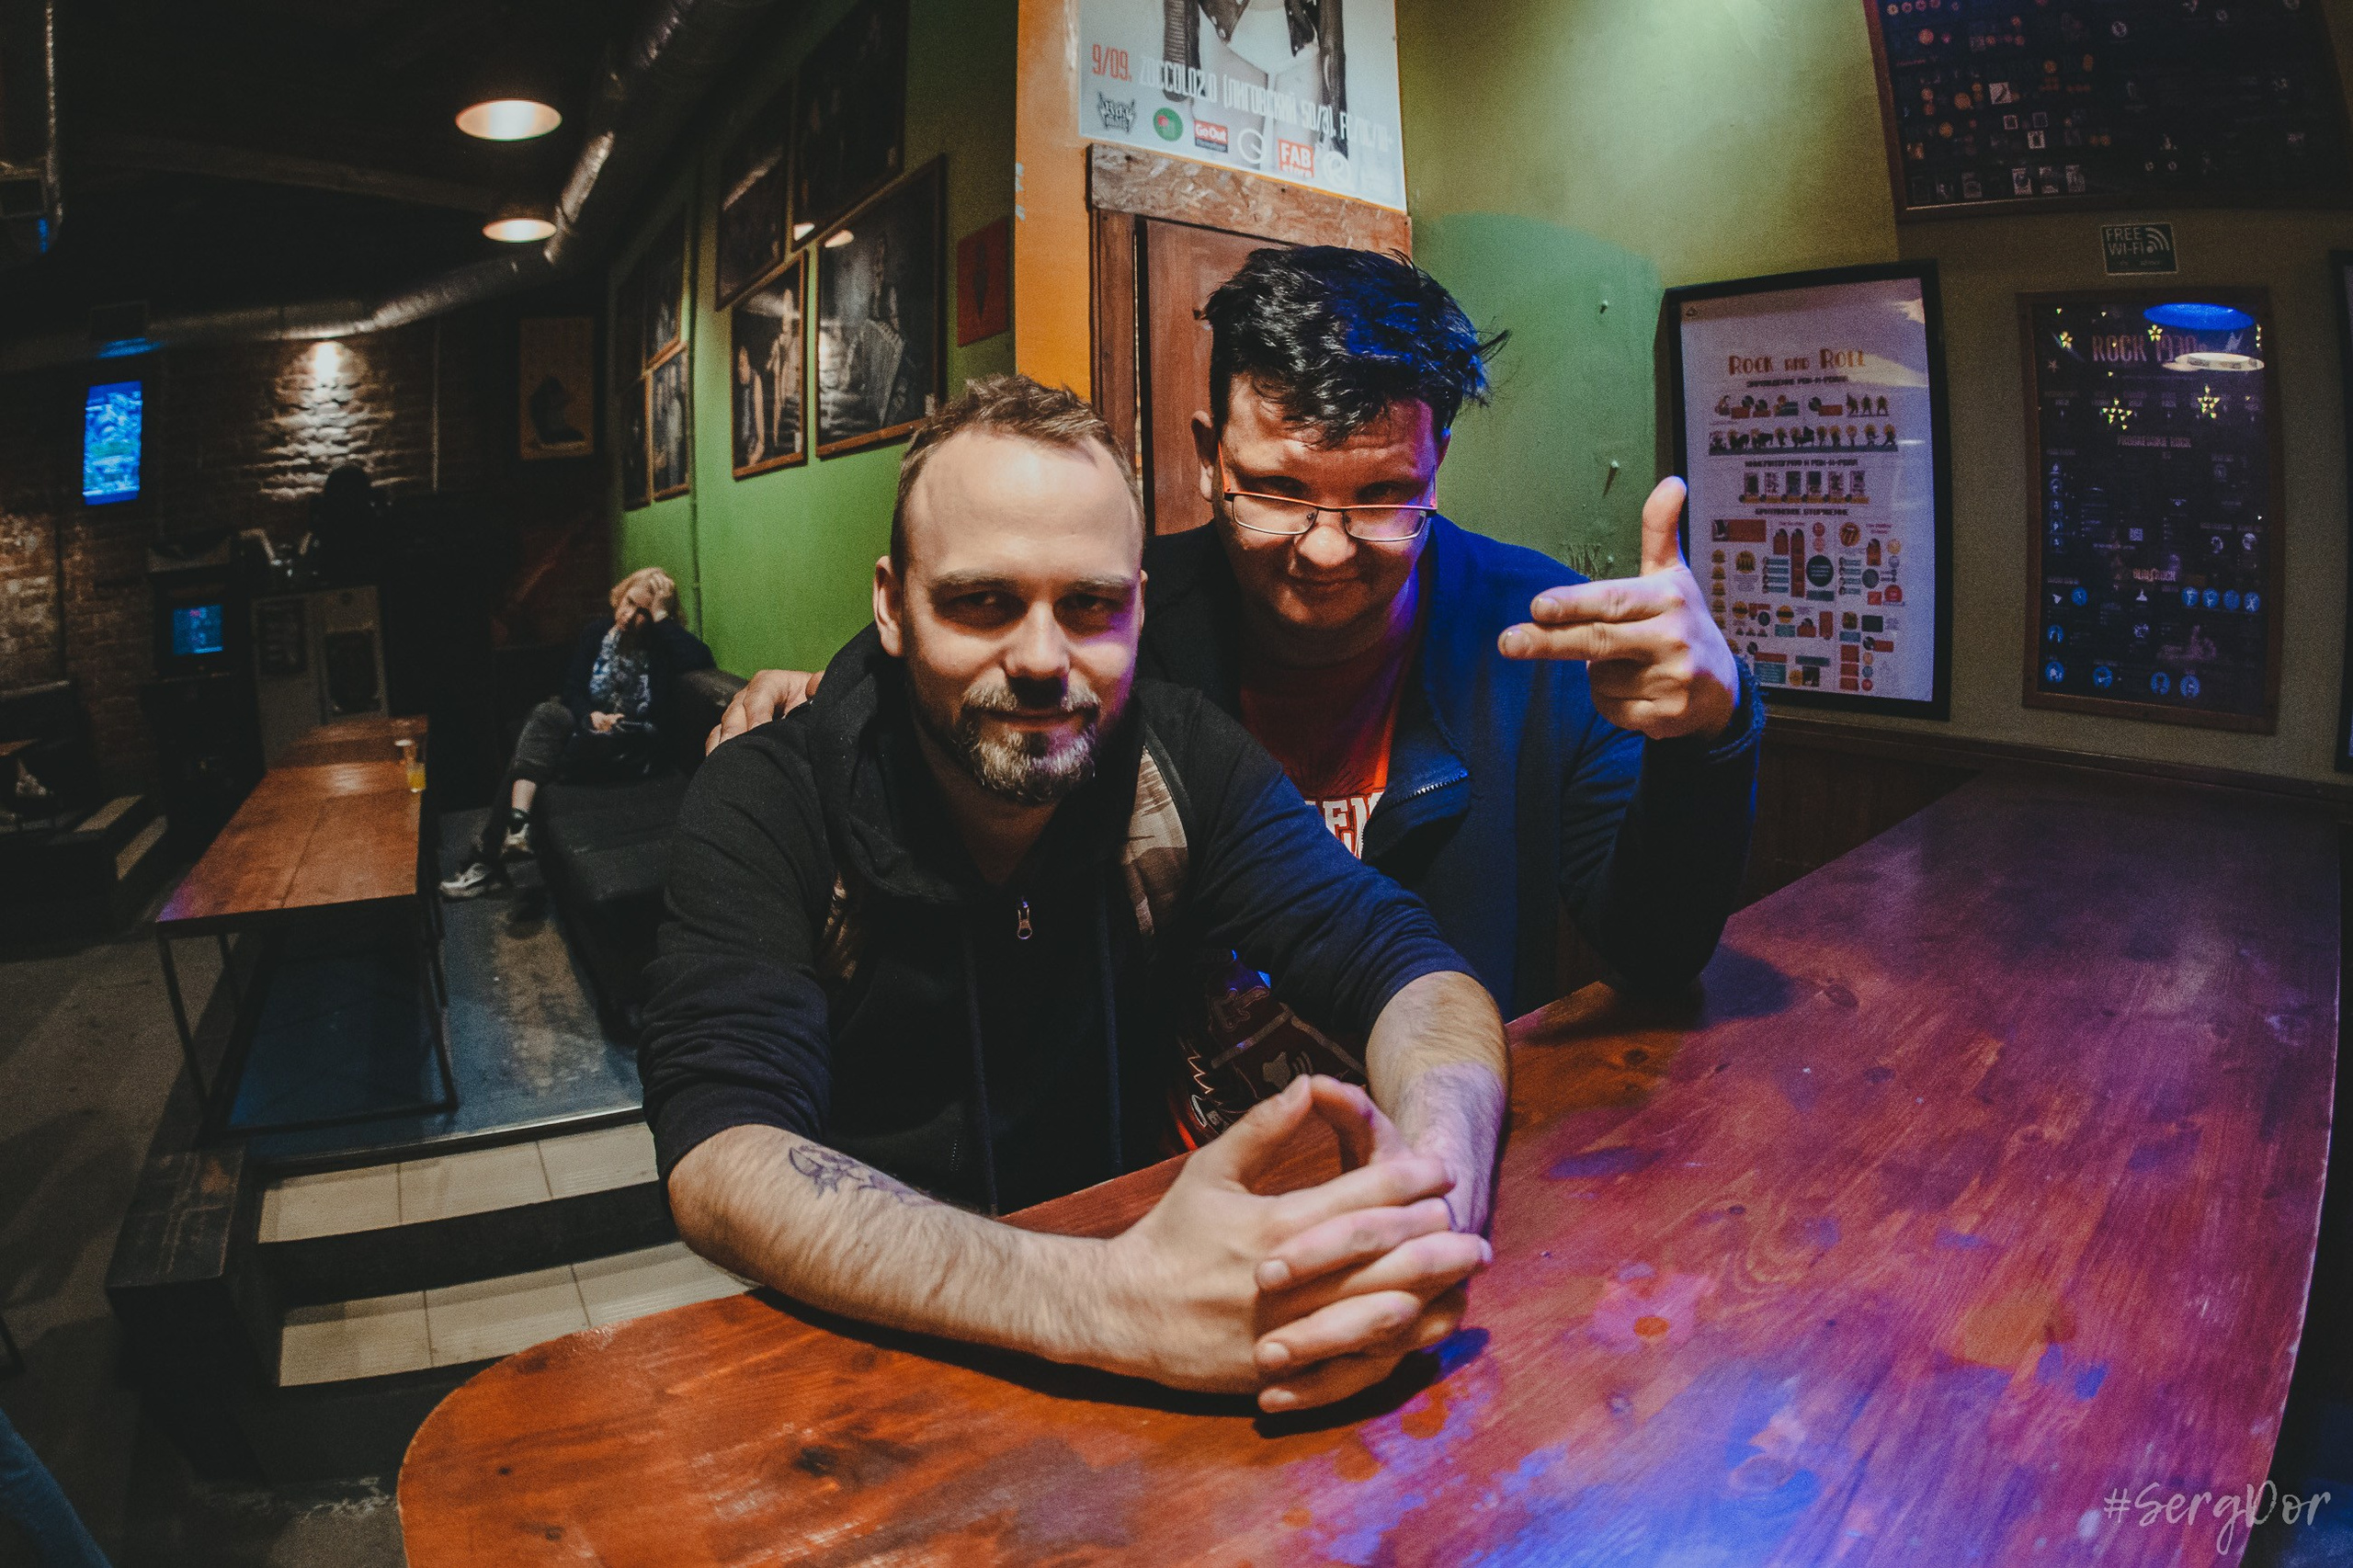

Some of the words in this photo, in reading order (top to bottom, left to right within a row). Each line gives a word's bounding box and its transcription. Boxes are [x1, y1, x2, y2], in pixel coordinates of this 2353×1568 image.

[1280, 142, 1313, 169] FAB
[2106, 227, 2143, 242] FREE
[2109, 242, 2144, 256] WI-FI
[2092, 334, 2147, 362] ROCK
